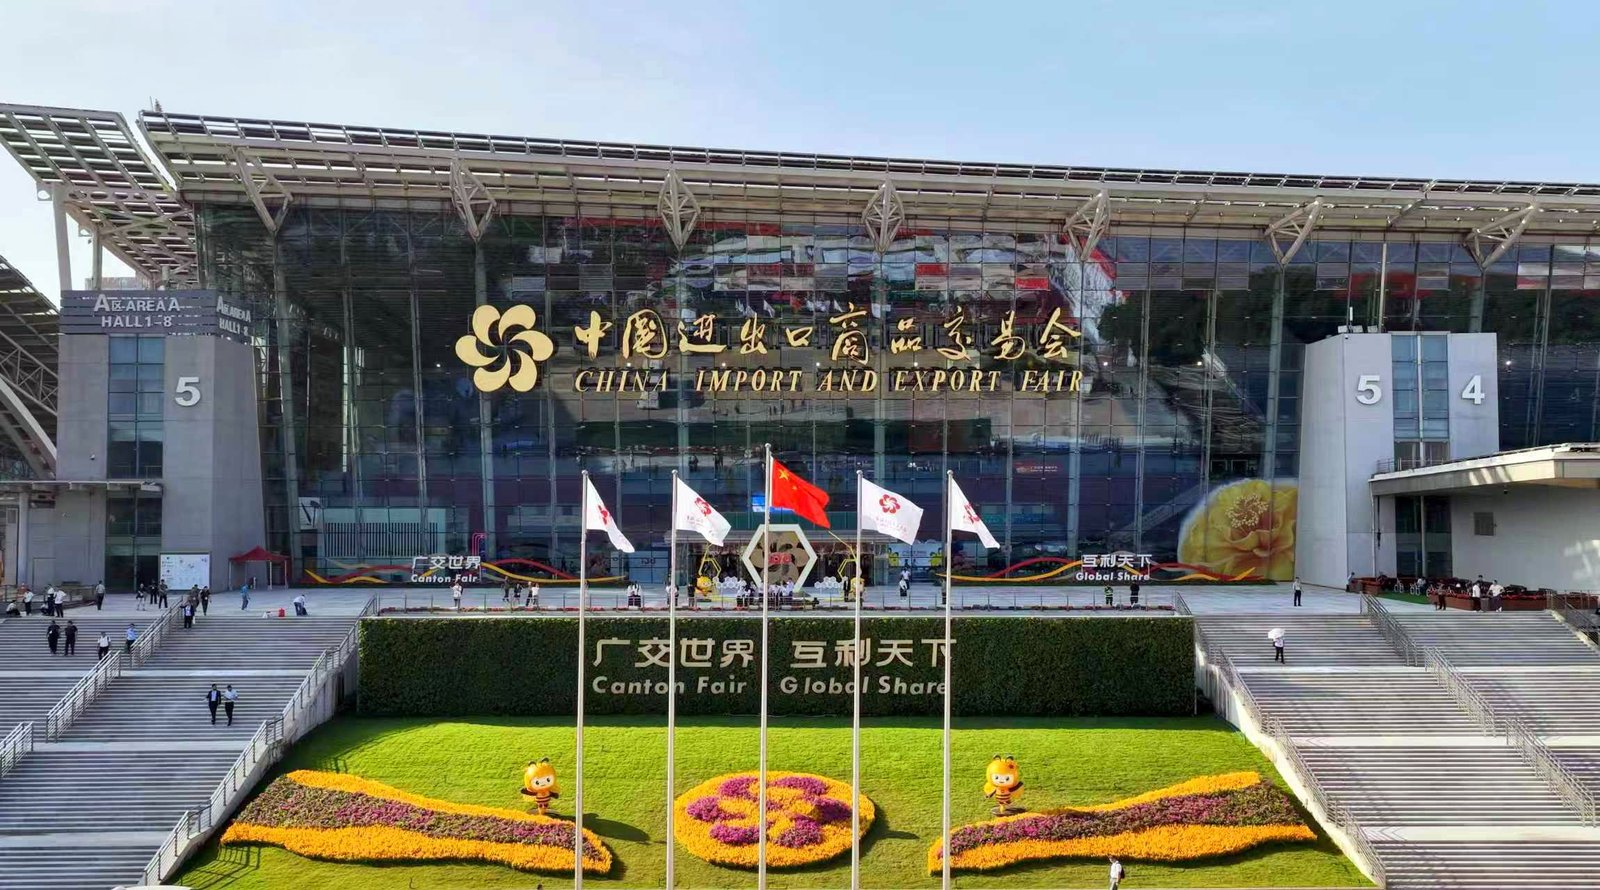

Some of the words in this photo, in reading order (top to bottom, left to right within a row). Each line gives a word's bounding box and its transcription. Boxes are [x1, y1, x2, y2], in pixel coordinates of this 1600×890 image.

[125, 299, 166, 312] AREA
[168, 297, 181, 312] A
[101, 315, 143, 328] HALL
[574, 369, 668, 393] CHINA
[694, 369, 803, 393] IMPORT
[816, 369, 879, 393] AND
[893, 369, 1001, 393] EXPORT
[1020, 369, 1084, 393] FAIR
[1356, 374, 1383, 405] 5
[175, 376, 202, 407] 5
[1461, 375, 1486, 405] 4
[411, 555, 481, 569] 广交世界
[1081, 554, 1153, 568] 互利天下
[410, 573, 451, 583] Canton
[1075, 571, 1114, 581] Global
[1116, 571, 1150, 581] Share
[593, 637, 754, 668] 广交世界
[790, 637, 957, 668] 互利天下
[592, 676, 685, 695] Canton
[697, 675, 748, 695] Fair
[780, 675, 869, 695] Global
[878, 675, 949, 695] Share
